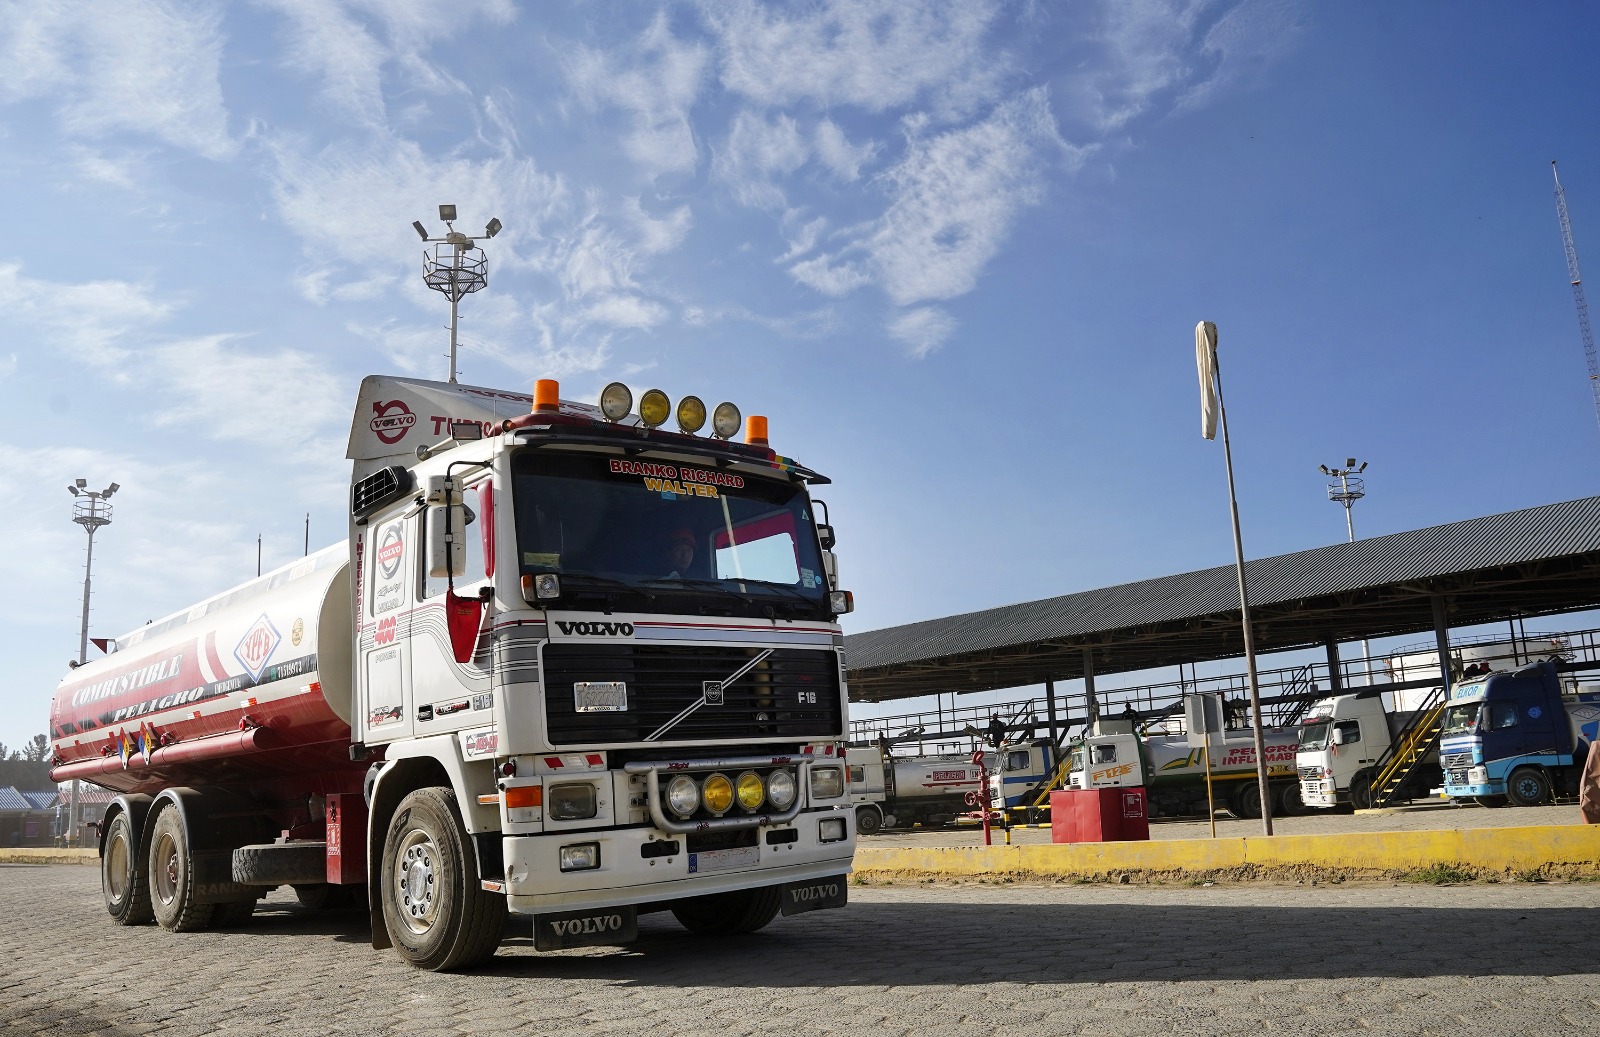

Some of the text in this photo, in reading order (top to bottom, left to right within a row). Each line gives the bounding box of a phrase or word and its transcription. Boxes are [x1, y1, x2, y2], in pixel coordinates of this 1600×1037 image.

[373, 416, 415, 428] VOLVO
[610, 459, 744, 488] BRANKO RICHARD
[644, 477, 719, 499] WALTER
[379, 545, 401, 560] VOLVO
[555, 620, 634, 636] VOLVO
[244, 627, 271, 662] YPFB
[71, 654, 183, 707] COMBUSTIBLE
[797, 691, 817, 703] F16
[1456, 685, 1479, 699] ELKOR
[112, 686, 205, 723] PELIGRO
[1228, 743, 1299, 756] PELGRO
[934, 771, 966, 781] PELIGRO
[791, 884, 839, 903] VOLVO
[550, 914, 622, 936] VOLVO
